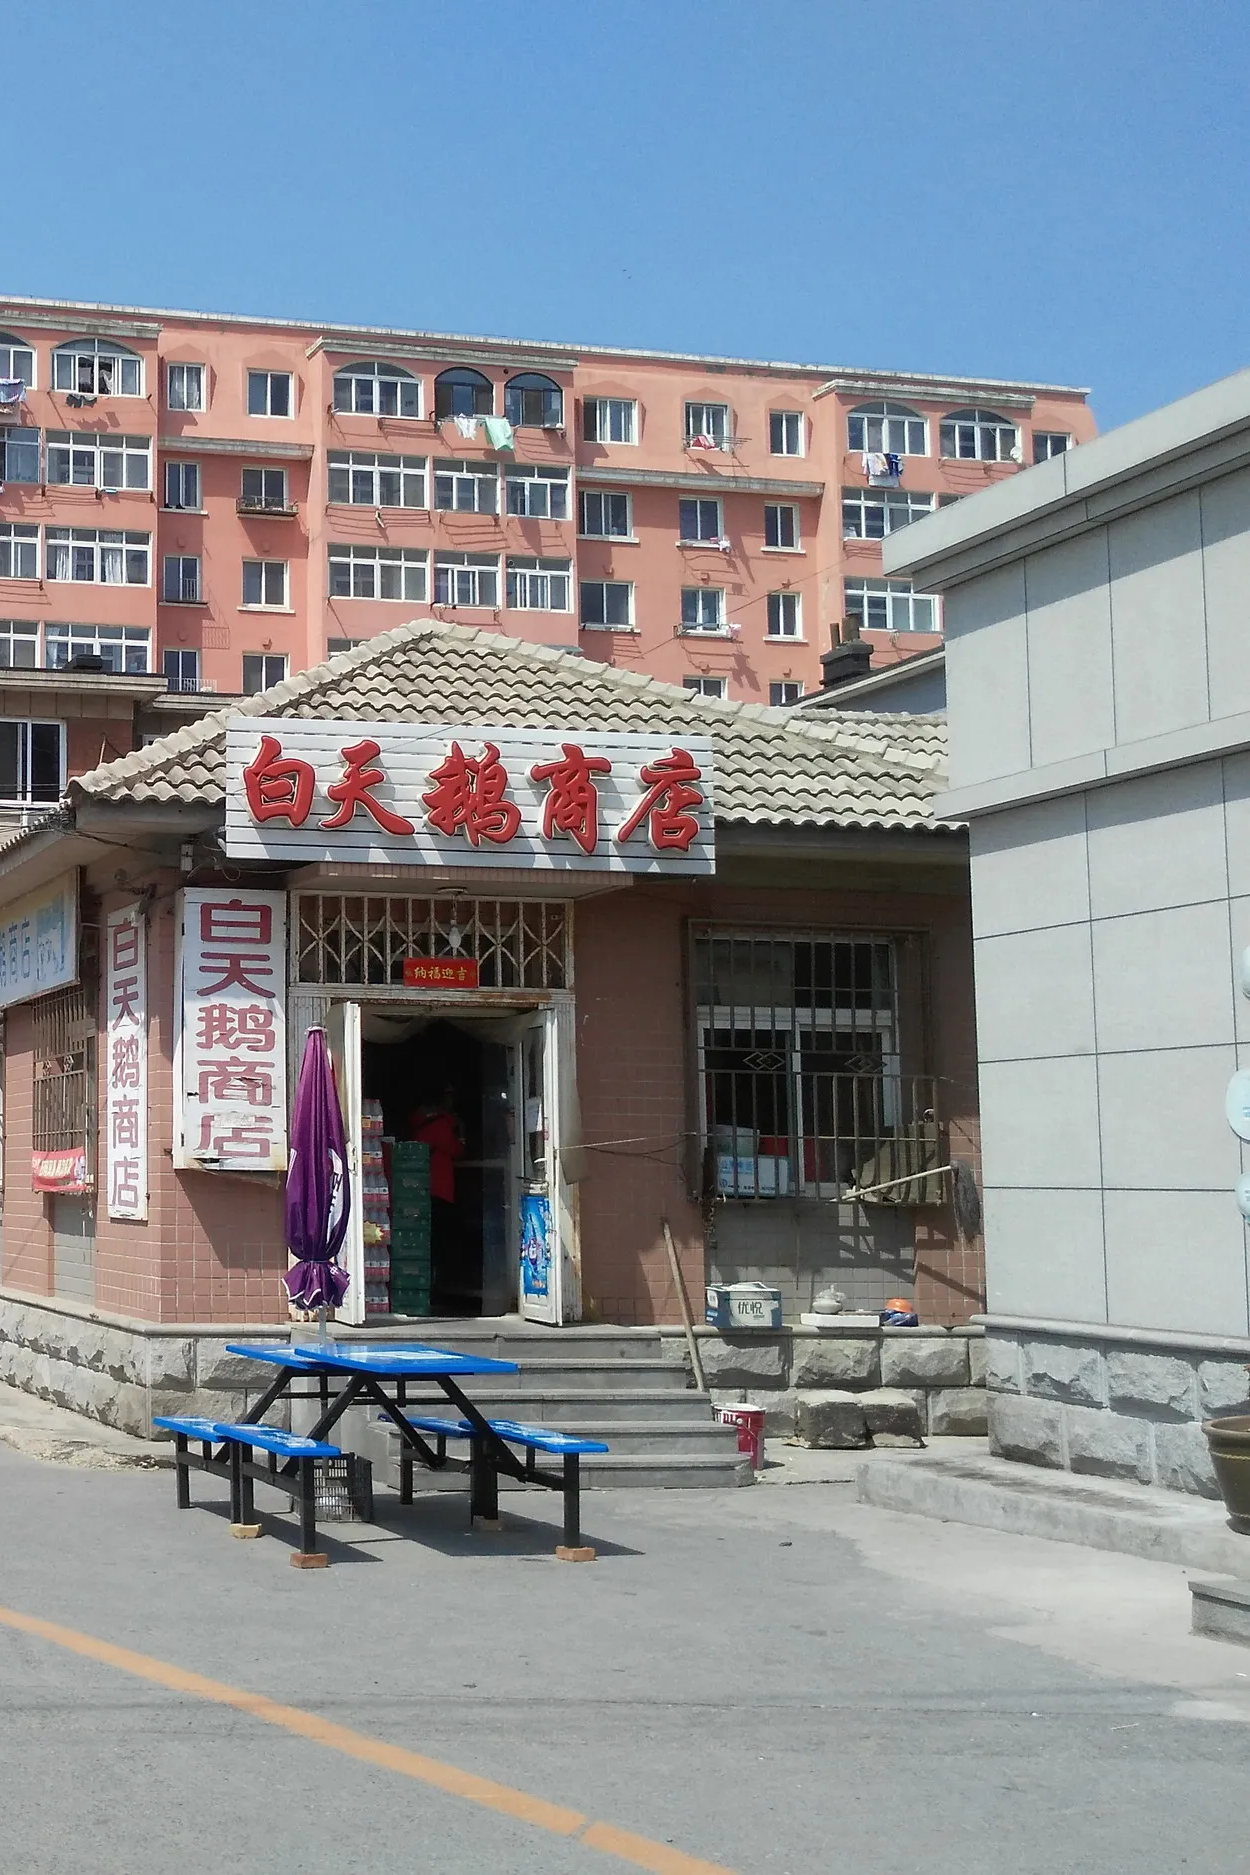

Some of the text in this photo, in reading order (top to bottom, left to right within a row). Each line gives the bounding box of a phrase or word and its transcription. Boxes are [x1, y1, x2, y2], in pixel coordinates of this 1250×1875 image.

[242, 735, 704, 855] 白天鹅商店
[111, 917, 140, 1209] 白天鹅商店
[196, 899, 276, 1158] 白天鹅商店
